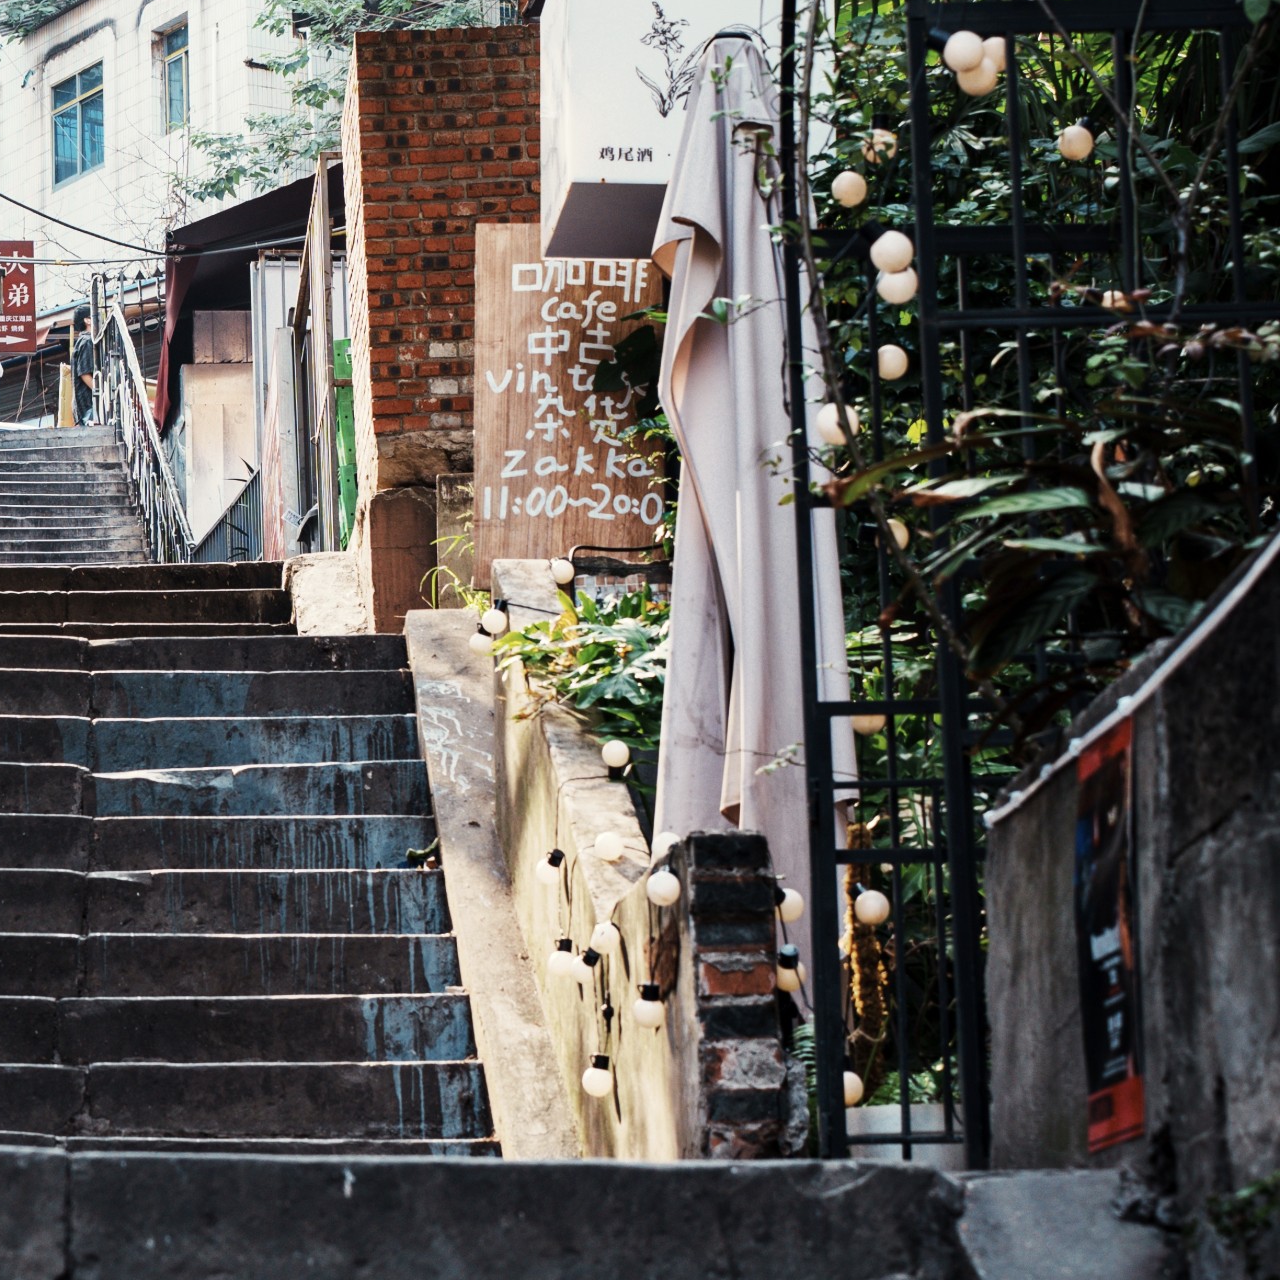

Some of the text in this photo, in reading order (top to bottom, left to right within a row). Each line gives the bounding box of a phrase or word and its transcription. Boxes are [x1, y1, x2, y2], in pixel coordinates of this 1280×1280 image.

[599, 147, 653, 162] 鸡尾酒
[512, 260, 648, 302] 咖啡
[528, 323, 618, 366] 中古
